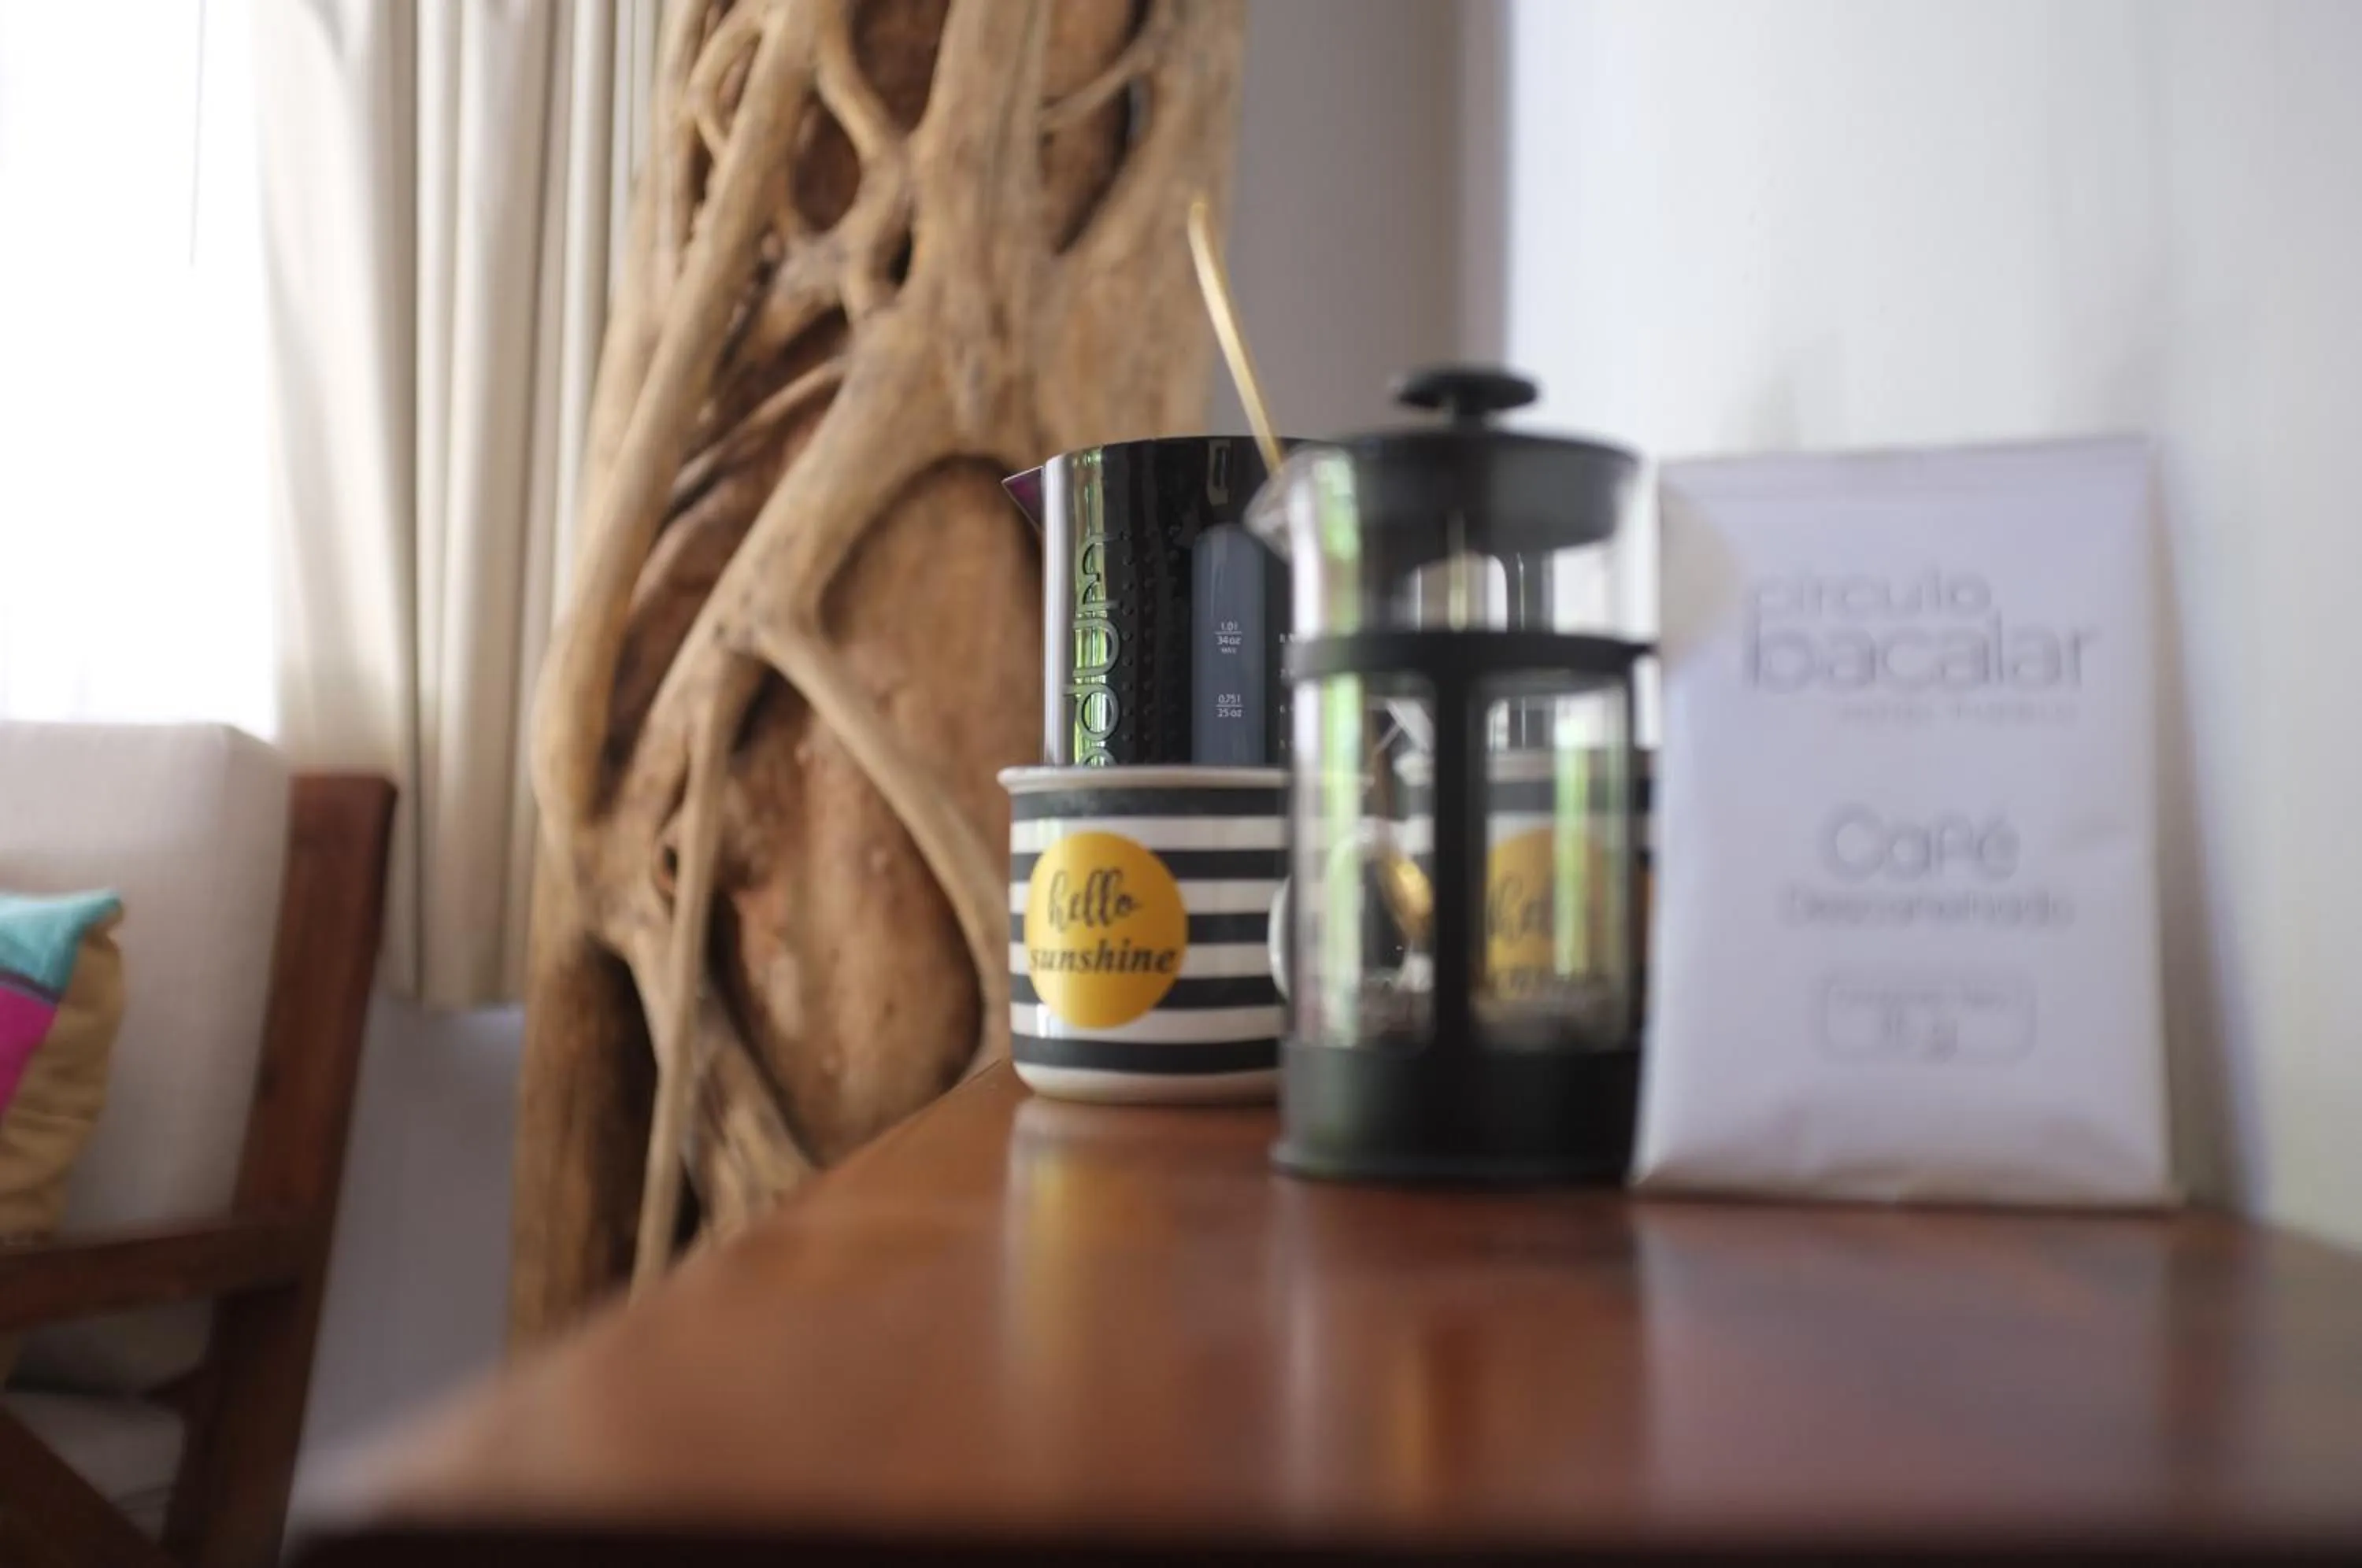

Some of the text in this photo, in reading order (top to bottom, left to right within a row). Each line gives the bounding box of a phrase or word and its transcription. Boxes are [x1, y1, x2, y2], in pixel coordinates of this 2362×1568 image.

[1063, 532, 1124, 765] dum
[1742, 597, 2104, 693] bacalar
[1820, 801, 2019, 884] Café
[1047, 867, 1143, 933] hello
[1029, 941, 1178, 975] sunshine
